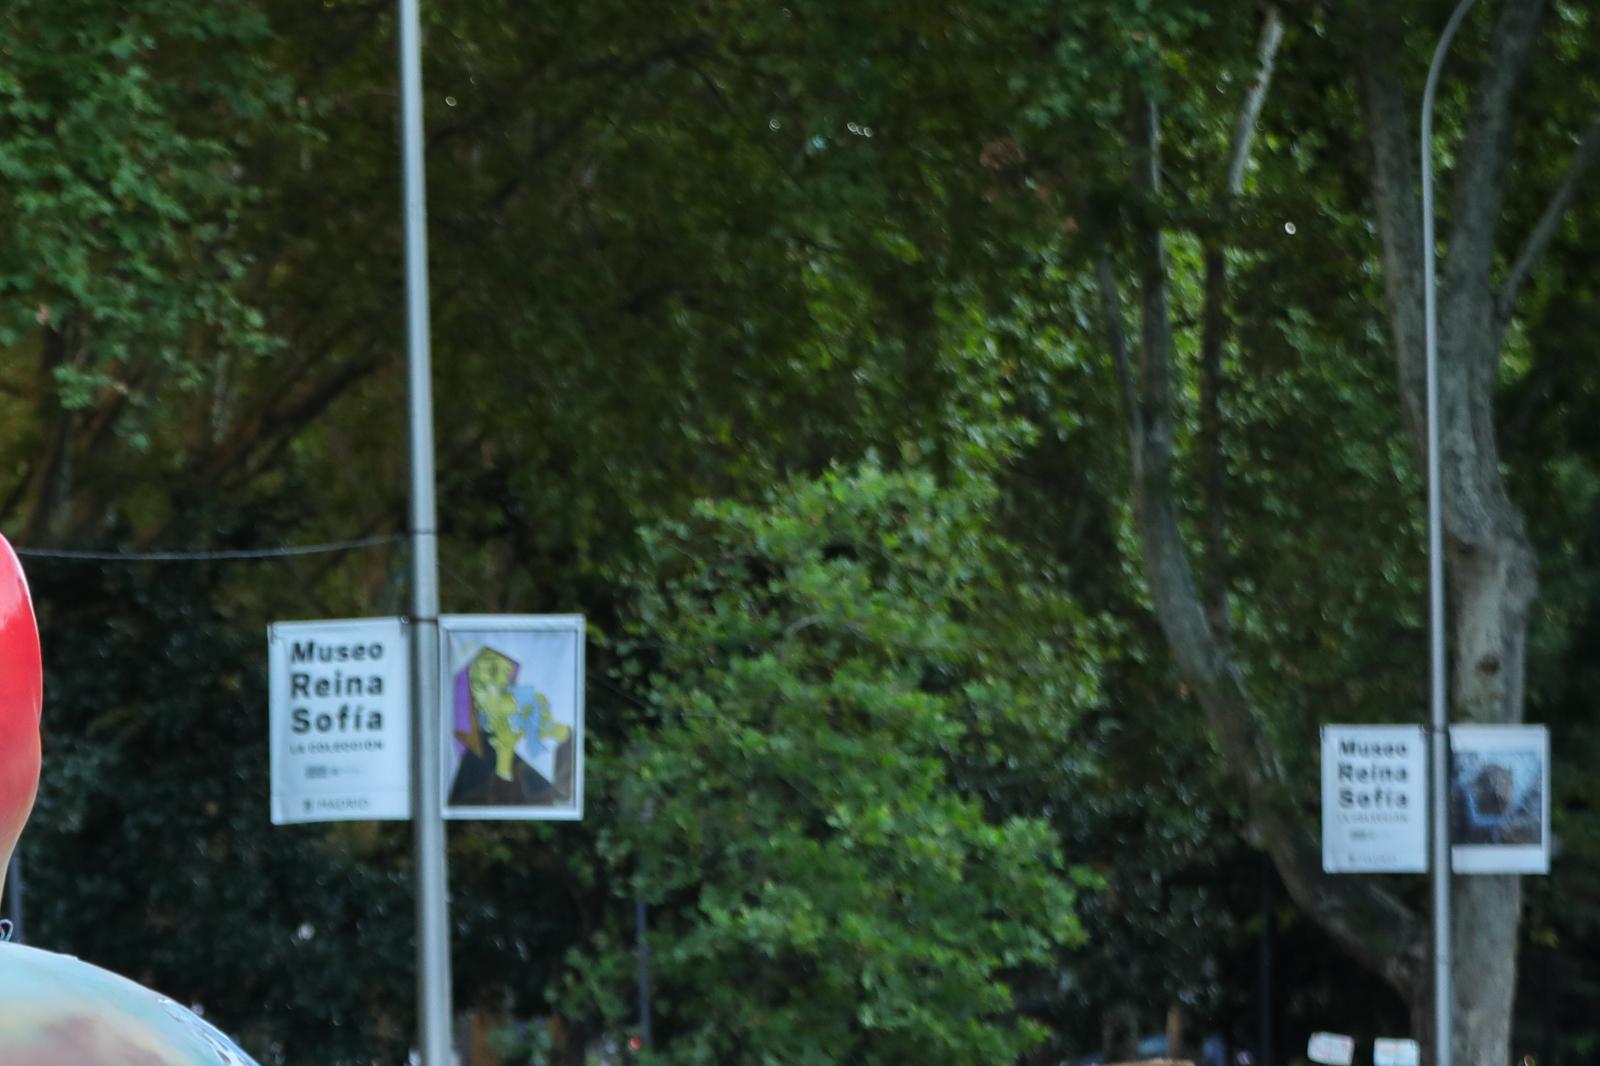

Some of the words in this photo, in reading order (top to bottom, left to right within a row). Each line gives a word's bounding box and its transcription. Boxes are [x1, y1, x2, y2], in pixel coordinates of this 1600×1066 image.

[290, 639, 384, 664] Museo
[290, 669, 384, 697] Reina
[290, 704, 384, 733] Sofía
